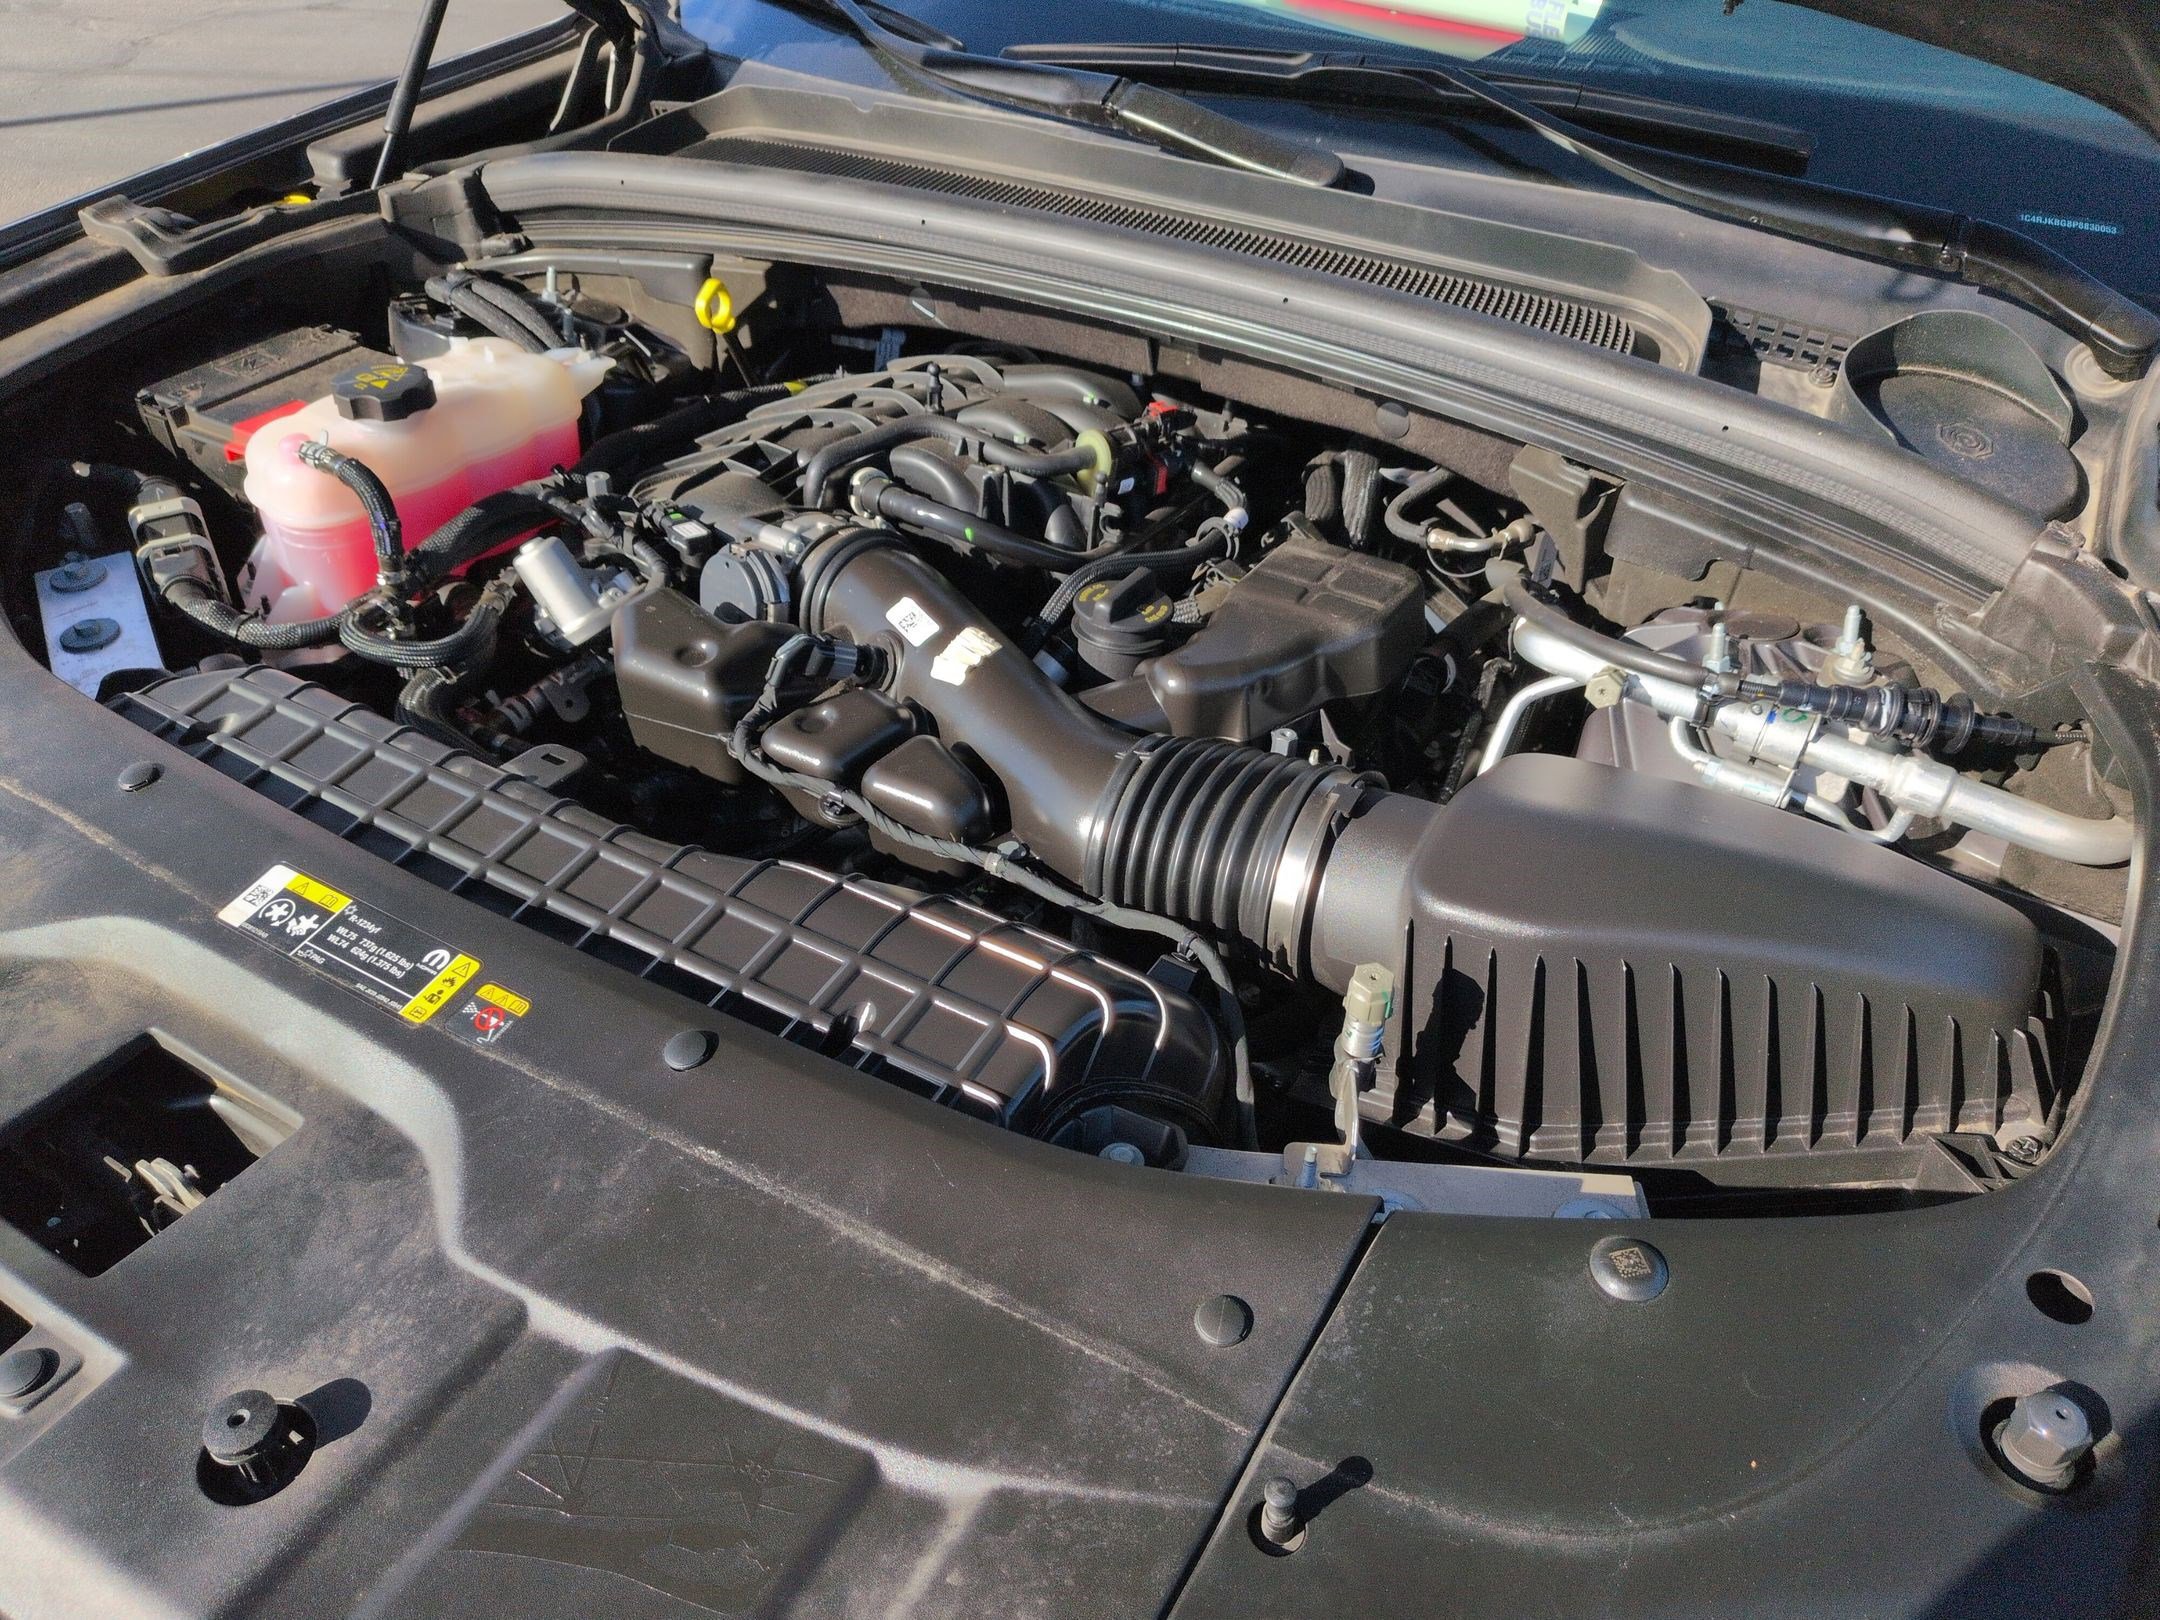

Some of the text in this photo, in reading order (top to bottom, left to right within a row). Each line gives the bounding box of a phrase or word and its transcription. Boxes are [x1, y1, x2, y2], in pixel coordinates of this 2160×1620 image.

[348, 914, 383, 934] R-1234yf
[326, 933, 406, 979] WL74 624g (1.375 lbs)
[335, 925, 415, 971] WL75 737g (1.625 lbs)
